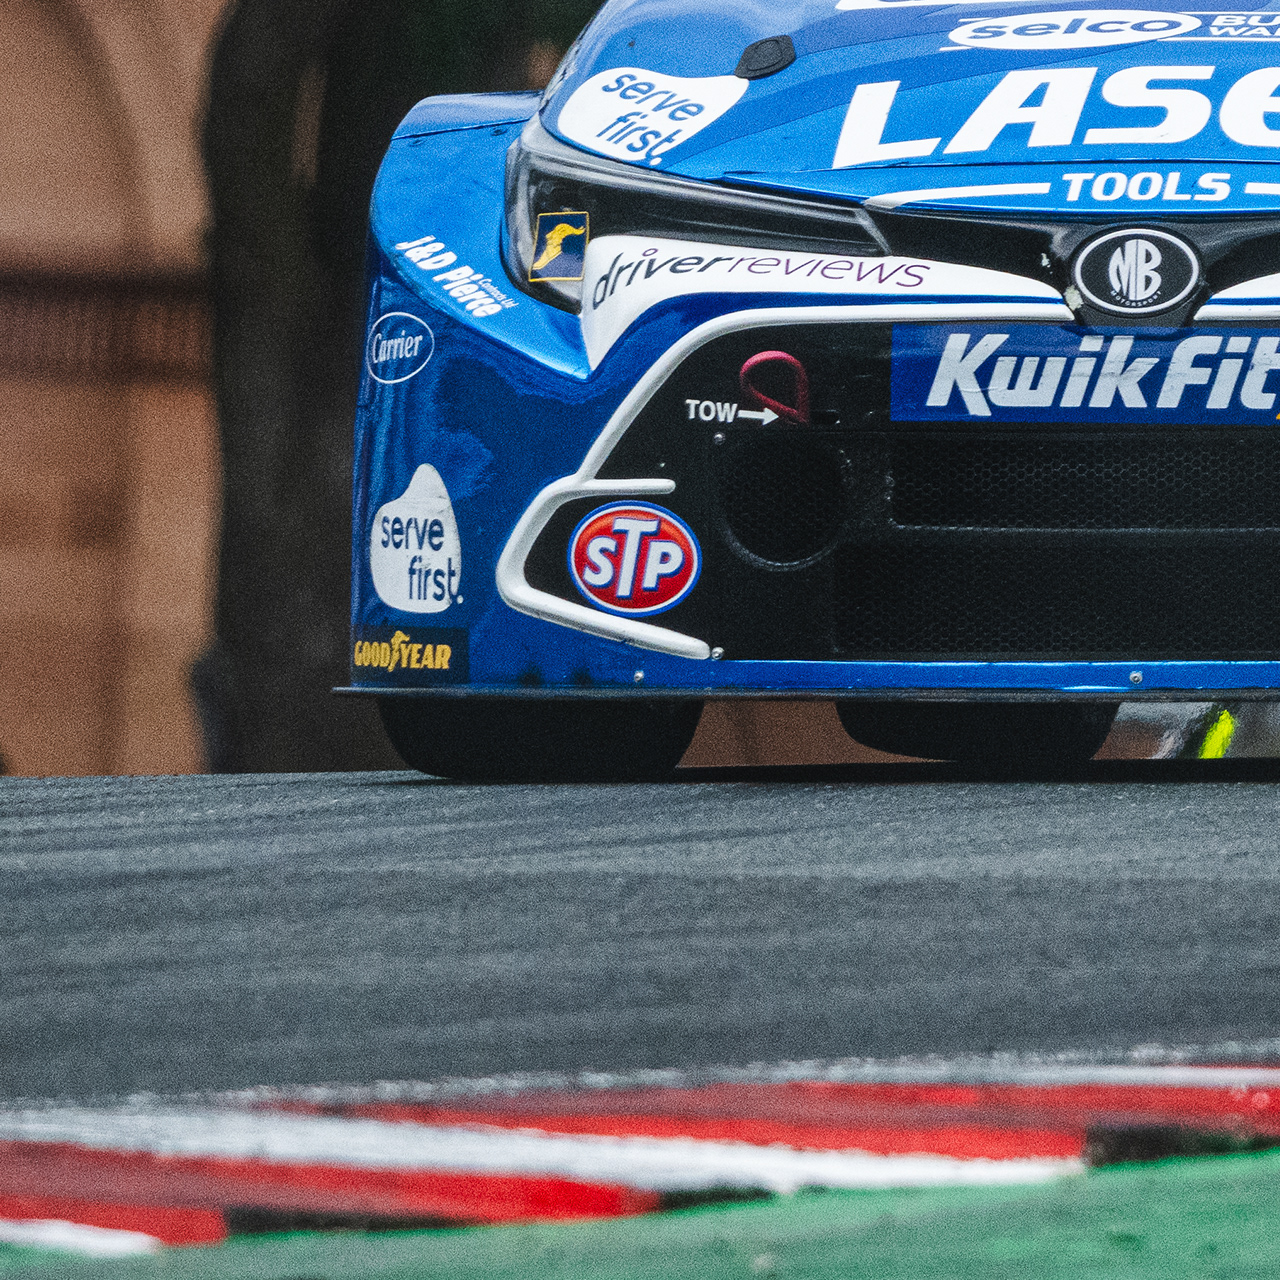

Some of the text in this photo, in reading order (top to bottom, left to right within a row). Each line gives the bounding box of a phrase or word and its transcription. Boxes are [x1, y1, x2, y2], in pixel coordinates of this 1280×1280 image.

[968, 17, 1183, 39] selco
[602, 73, 706, 121] serve
[1061, 171, 1232, 202] TOOLS
[394, 234, 503, 317] J&D Pierce
[1109, 289, 1162, 308] MOTORSPORT
[372, 329, 423, 363] Carrier
[686, 398, 738, 422] TOW
[380, 515, 445, 552] serve
[582, 517, 686, 599] STP
